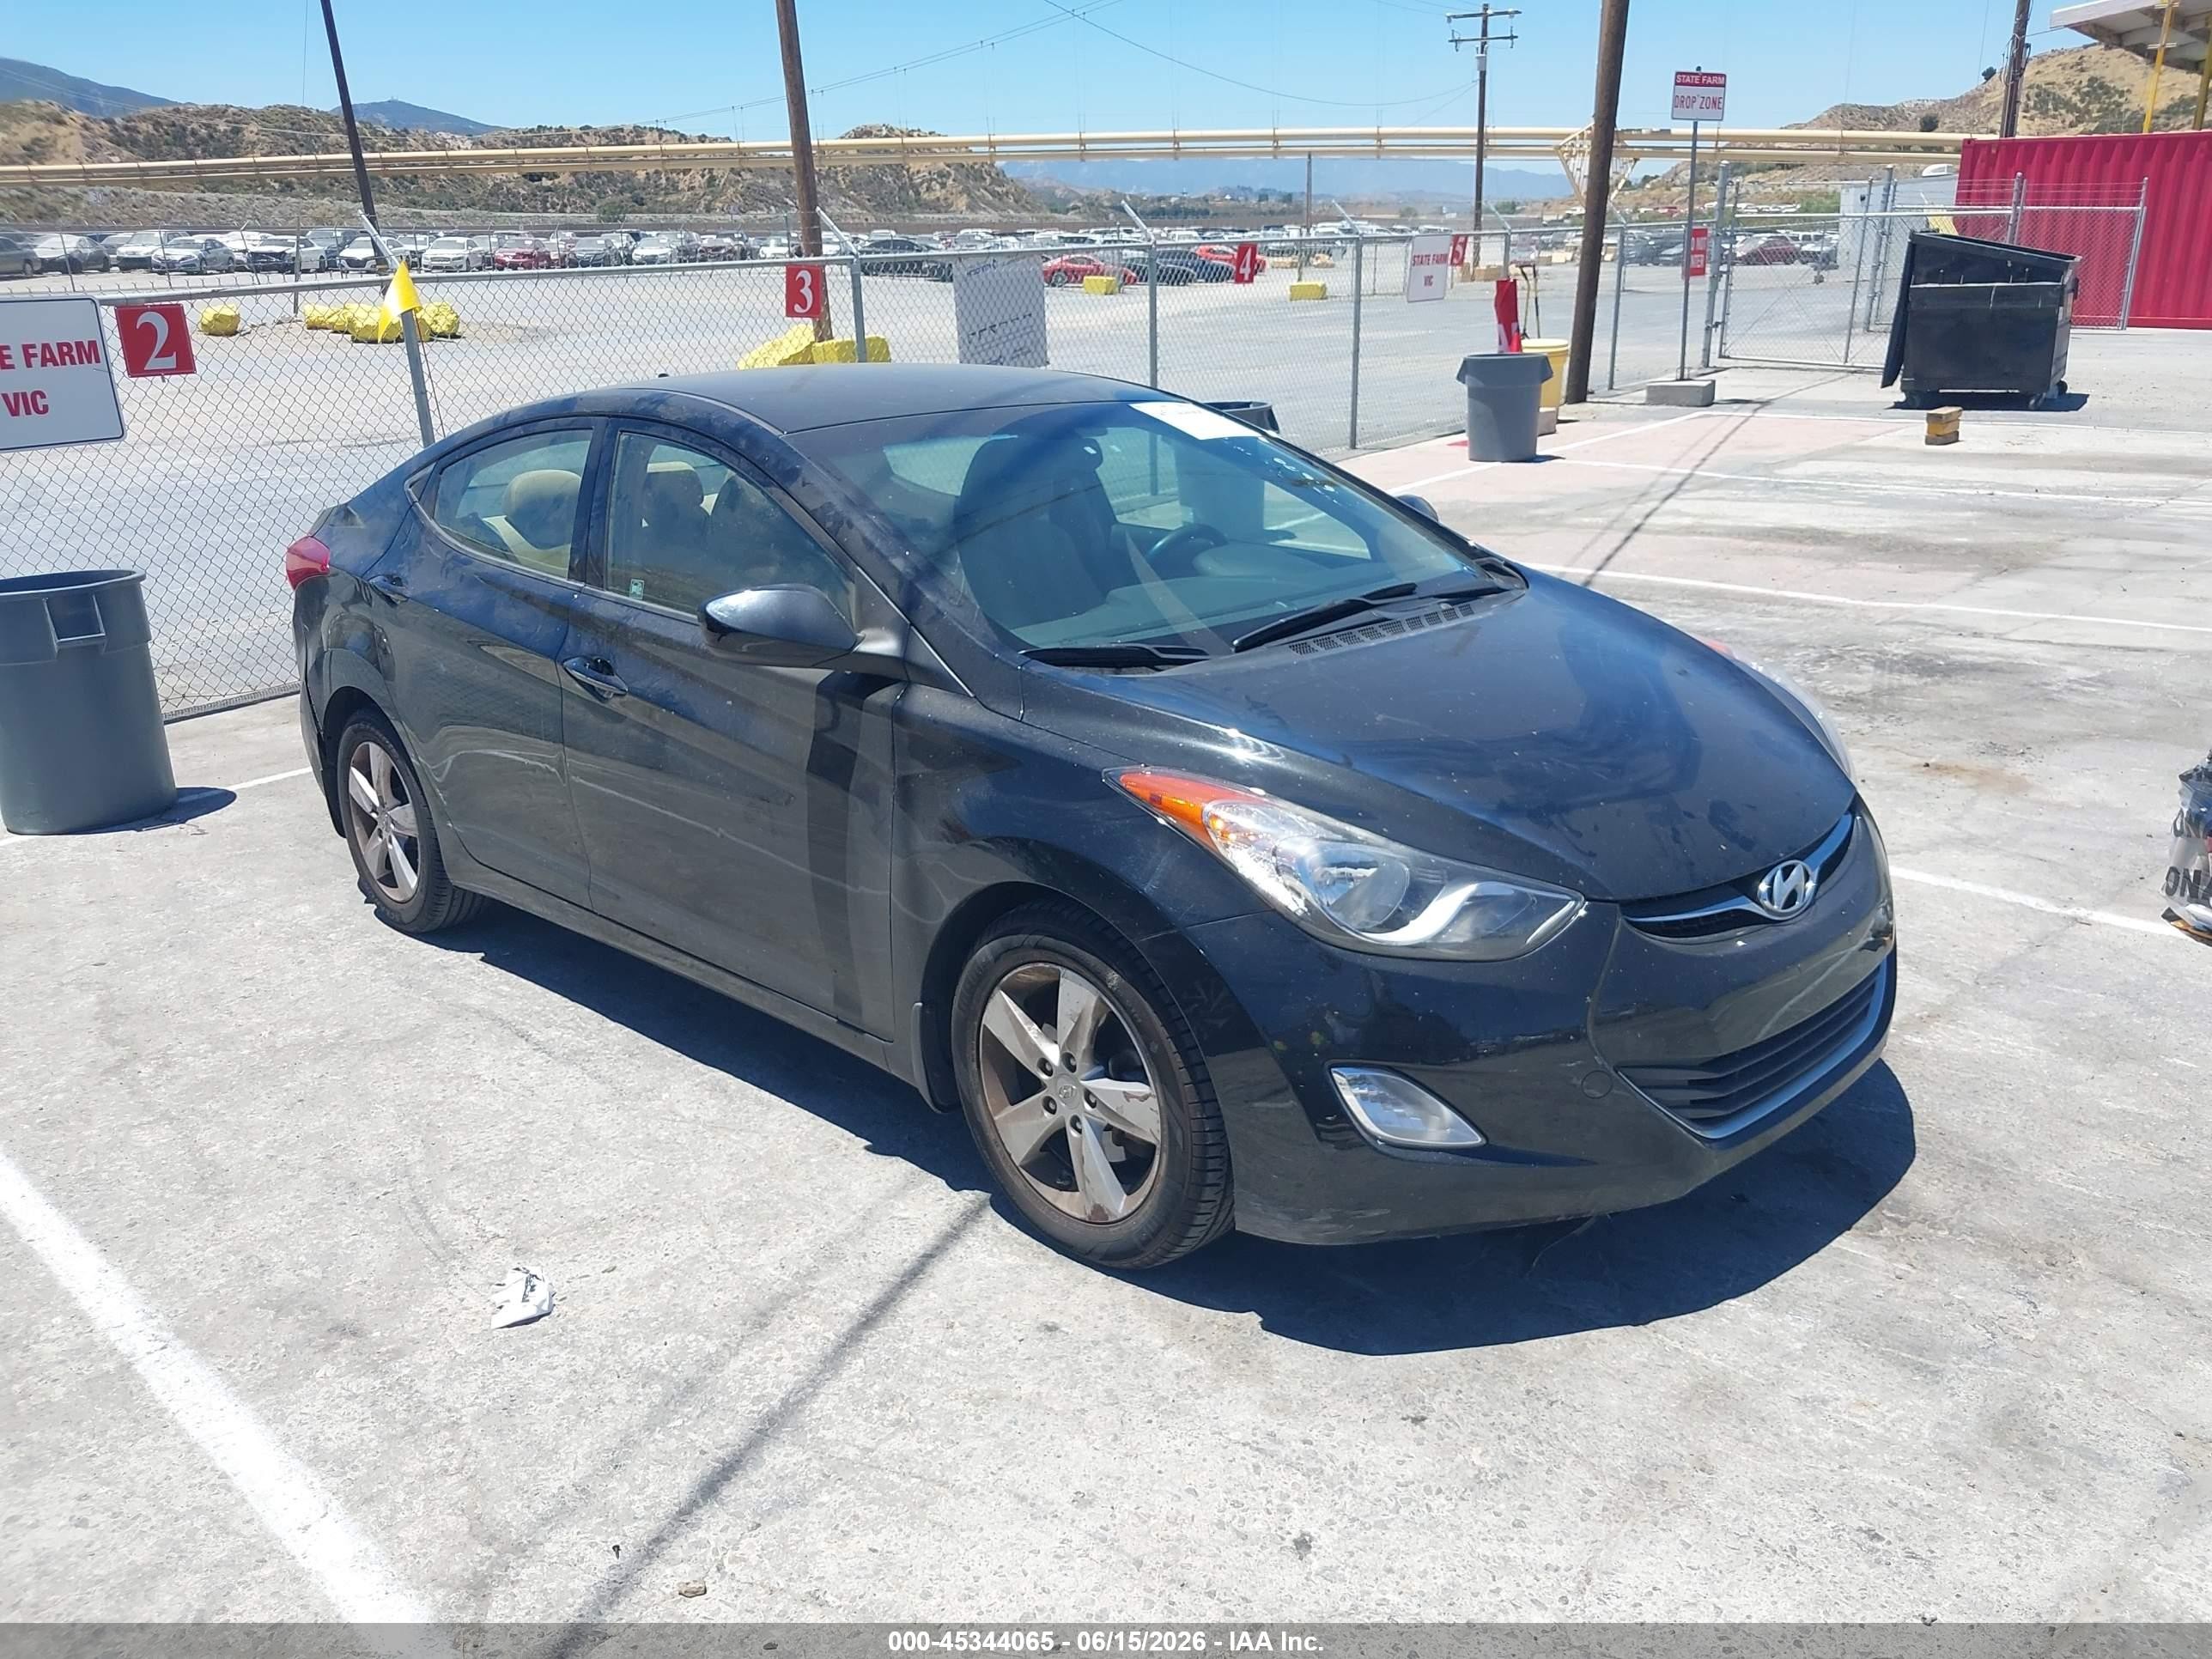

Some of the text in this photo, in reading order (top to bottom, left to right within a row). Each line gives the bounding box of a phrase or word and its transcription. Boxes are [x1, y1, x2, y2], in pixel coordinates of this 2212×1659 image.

[1675, 74, 1725, 84] STATE FARM
[1674, 94, 1723, 110] DROP ZONE
[1412, 254, 1431, 267] STATE
[1453, 235, 1466, 264] 5
[1239, 246, 1252, 282] 4
[793, 269, 813, 314] 3
[21, 340, 101, 368] FARM
[136, 311, 178, 371] 2
[0, 390, 49, 417] VIC
